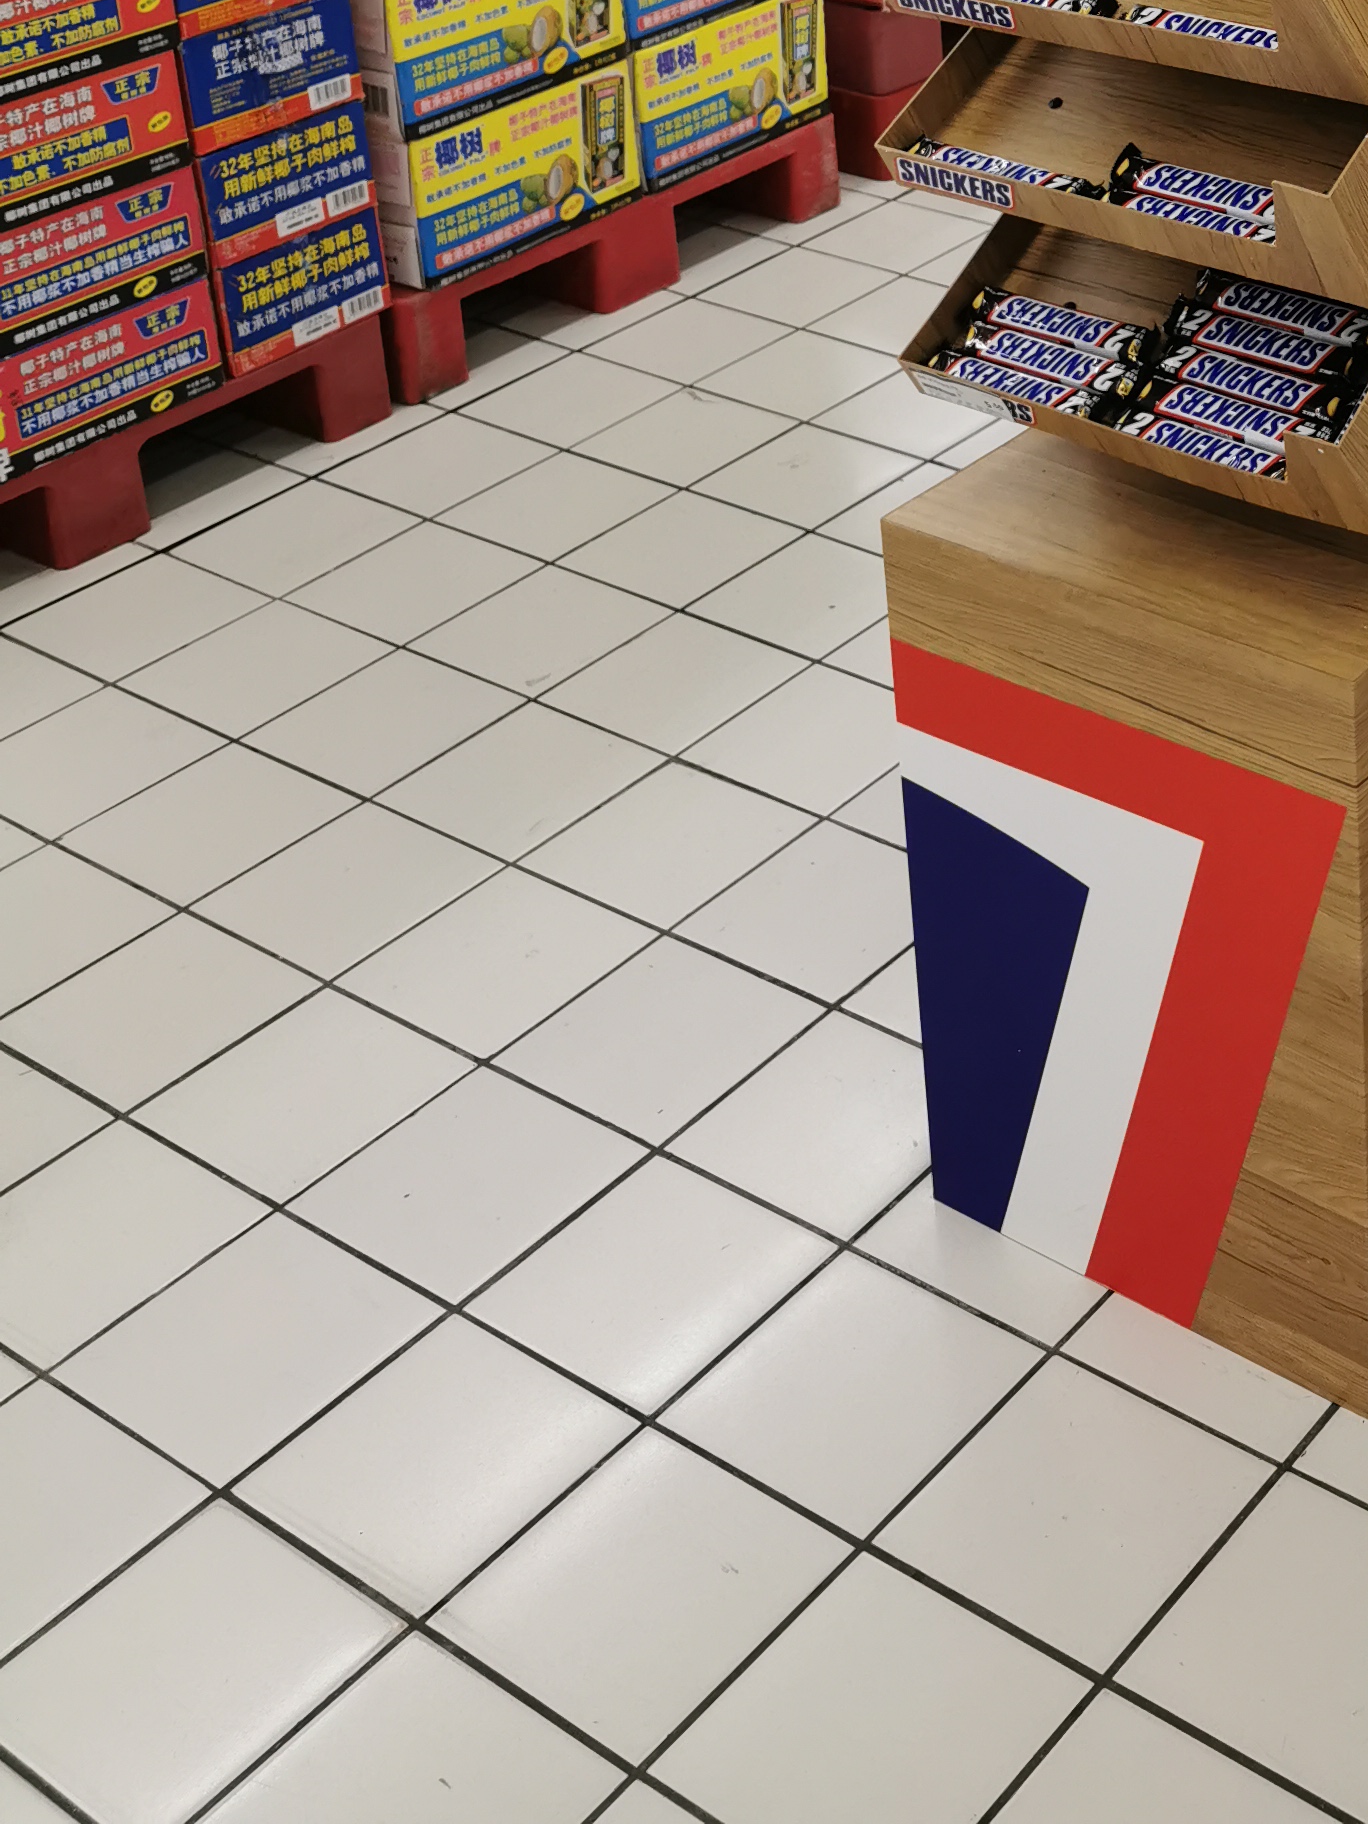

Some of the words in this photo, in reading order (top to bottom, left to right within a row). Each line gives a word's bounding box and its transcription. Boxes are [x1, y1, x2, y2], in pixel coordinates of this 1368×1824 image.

[899, 160, 1012, 207] SNICKERS
[236, 223, 368, 295] 32年坚持在海南岛
[1202, 318, 1329, 370] SNICKERS
[1187, 354, 1315, 410] SNICKERS
